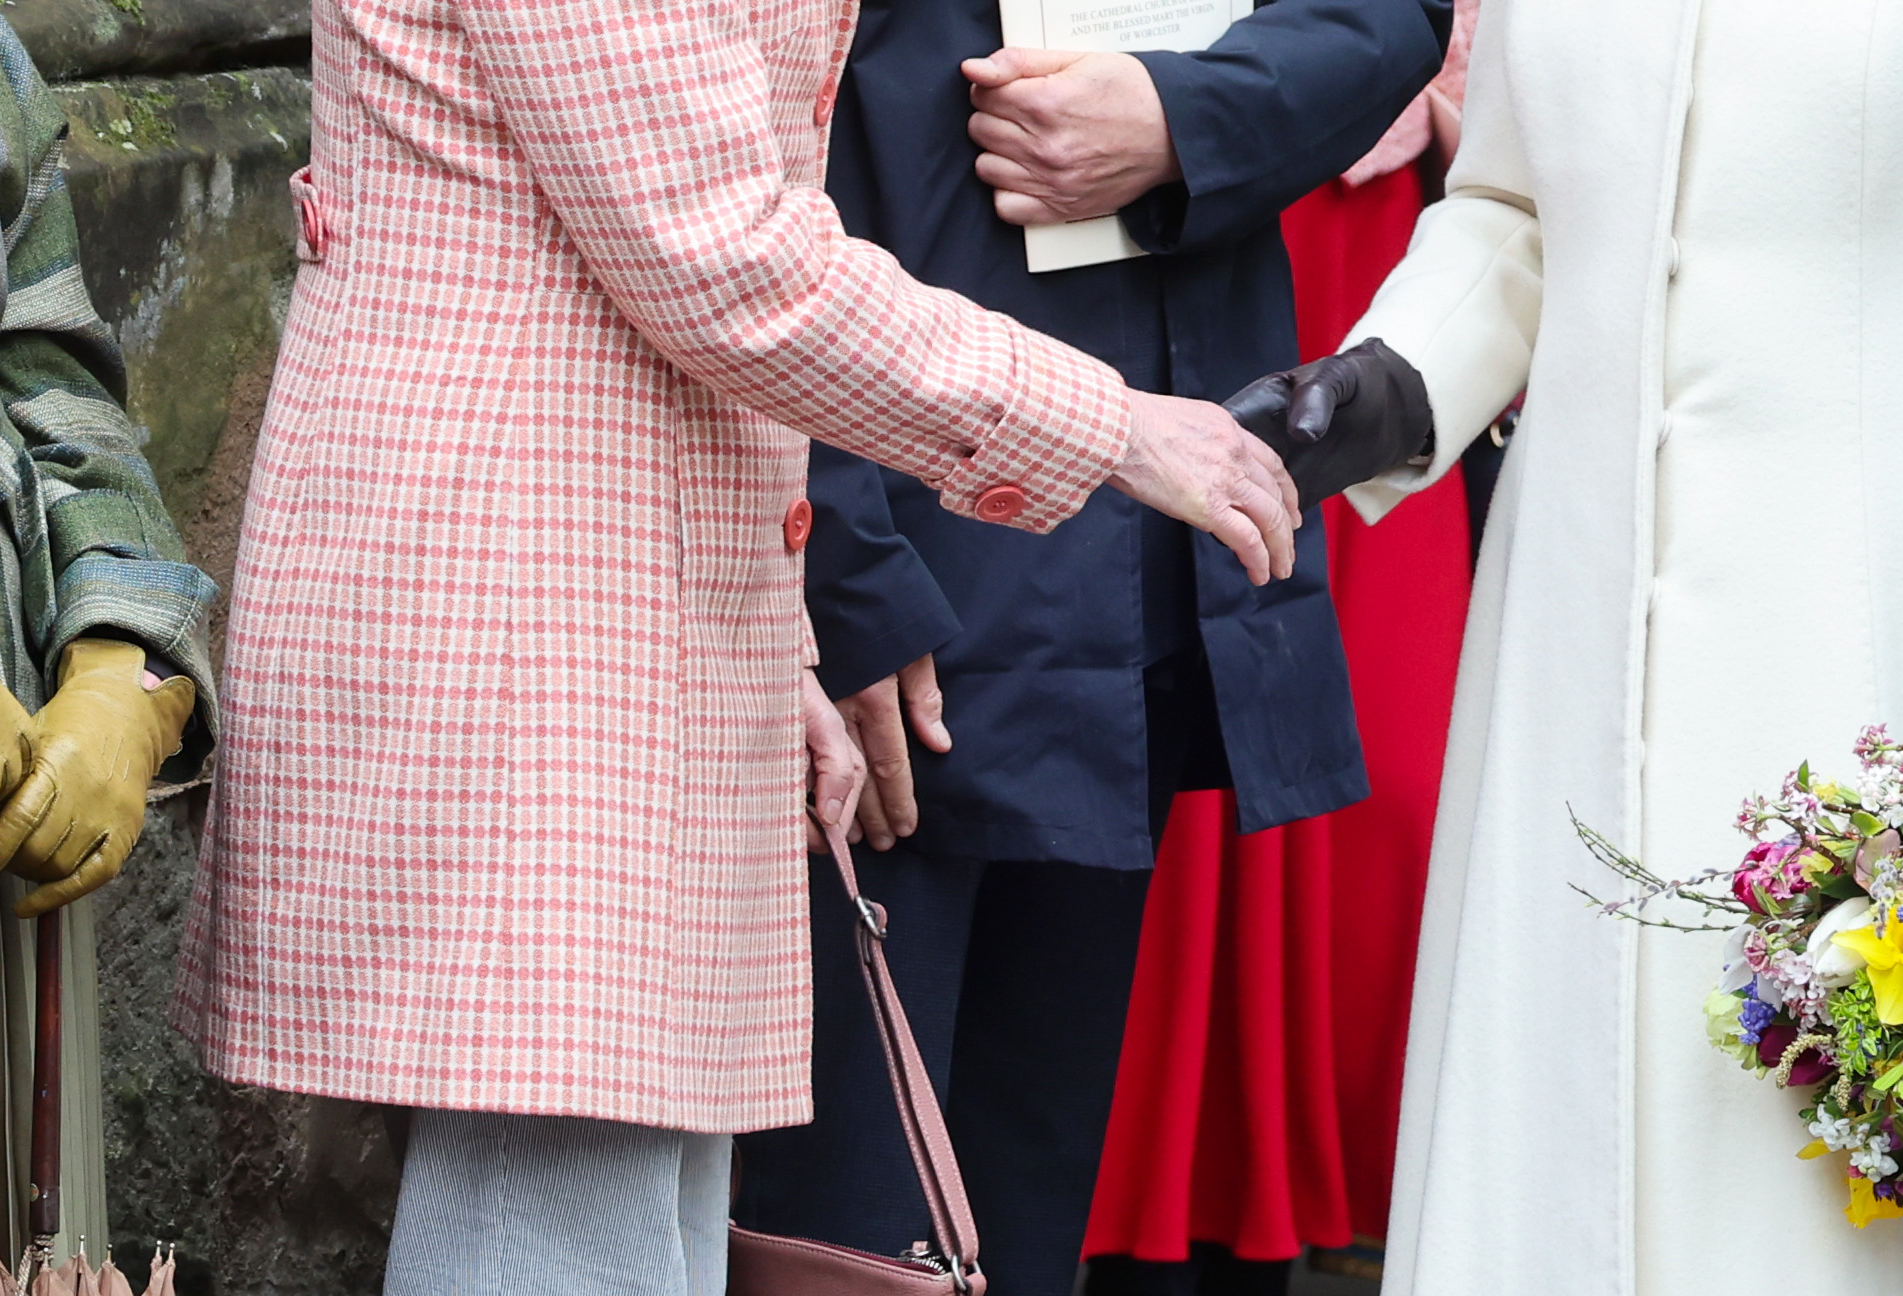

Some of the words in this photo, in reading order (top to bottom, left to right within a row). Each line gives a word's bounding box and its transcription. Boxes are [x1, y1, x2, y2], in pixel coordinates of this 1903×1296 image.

[1070, 12, 1088, 23] THE
[1090, 2, 1144, 21] CATHEDRAL
[1071, 25, 1091, 37] AND
[1093, 21, 1112, 33] THE
[1113, 15, 1151, 30] BLESSED
[1152, 10, 1175, 22] MARY
[1175, 7, 1189, 18] THE
[1190, 2, 1215, 15] VIRGIN
[1119, 31, 1132, 42] OF
[1133, 23, 1181, 39] WORCESTER
